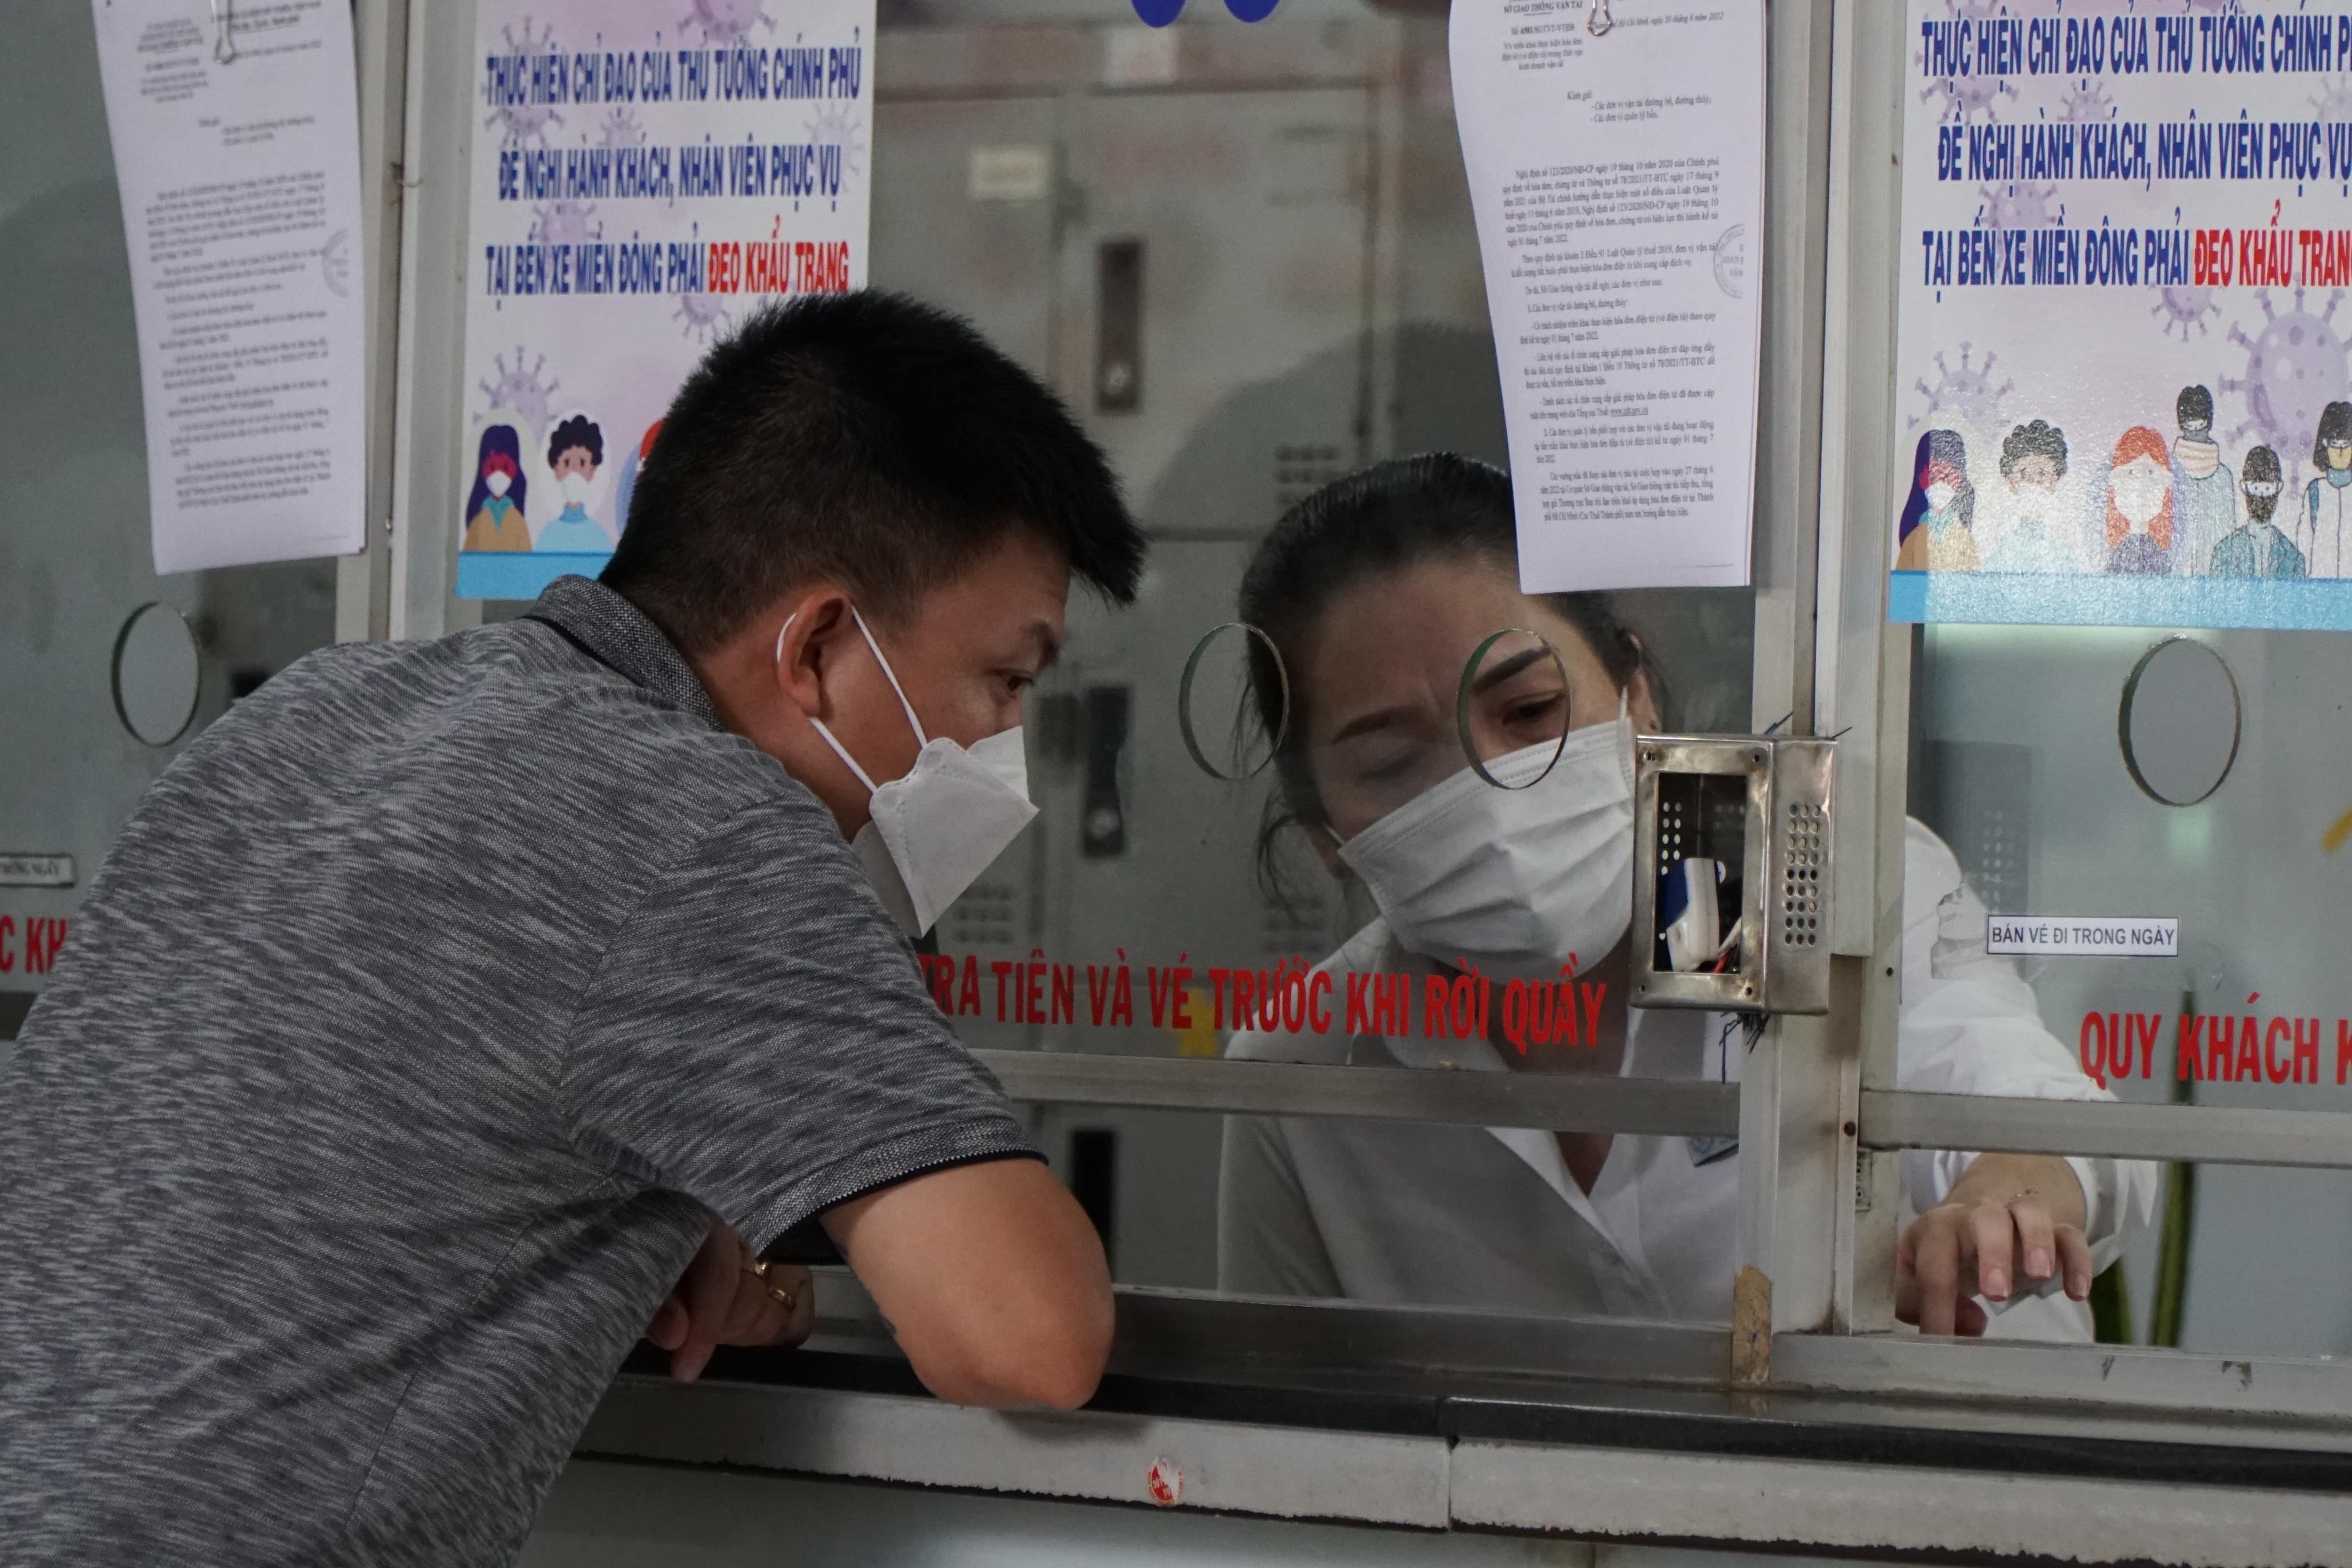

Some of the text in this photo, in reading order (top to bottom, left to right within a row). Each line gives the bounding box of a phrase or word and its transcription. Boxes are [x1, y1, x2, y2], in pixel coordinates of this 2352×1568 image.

[574, 32, 601, 103] CHỈ
[641, 31, 671, 102] CỦA
[678, 30, 709, 101] THỦ
[773, 33, 824, 100] CHÍNH
[829, 26, 861, 100] PHỦ
[1922, 0, 2352, 93] THỰC HIỆN CHỈ ĐẠO CỦA THỦ TƯỚNG CHÍNH P
[567, 134, 610, 198] HÀNH
[616, 132, 673, 207] KHÁCH,
[679, 133, 724, 197] NHÂN
[729, 132, 766, 196] VIÊN
[771, 145, 814, 212] PHỤC
[820, 145, 841, 212] VỤ
[1938, 101, 2352, 197] ĐỀ NGHỊ HÀNH KHÁCH, NHÂN VIÊN PHỤC VỤ
[486, 214, 849, 310] TẠI BẾN XE MIỀN ĐÔNG PHẢI ĐEO KHẨU TRANG
[1922, 199, 2352, 303] TẠI BẾN XE MIỀN ĐÔNG PHẢI ĐEO KHẨU TRAN
[1992, 924, 2174, 947] BÁN VÉ ĐI TRONG NGÀY
[991, 948, 1075, 1024] TIÊN
[1087, 948, 1133, 1026] VÀ
[1147, 953, 1193, 1029] VÉ
[1208, 955, 1333, 1034] TRƯỚC
[1346, 971, 1410, 1036] KHI
[1424, 957, 1490, 1040] RỜI
[1503, 952, 1606, 1056] QUẦY
[2080, 1011, 2162, 1090] QUY
[2178, 992, 2319, 1084] KHÁCH
